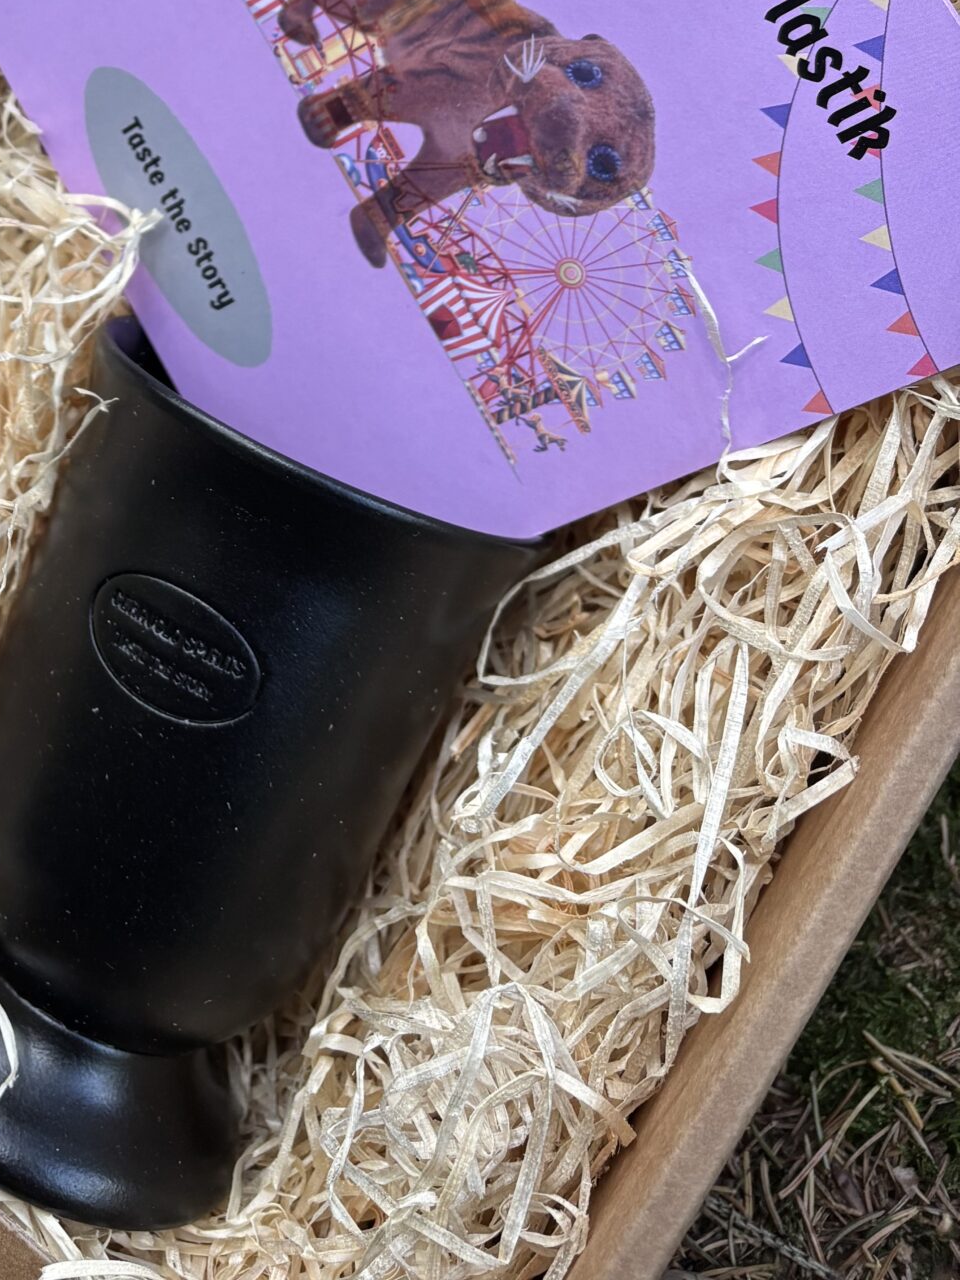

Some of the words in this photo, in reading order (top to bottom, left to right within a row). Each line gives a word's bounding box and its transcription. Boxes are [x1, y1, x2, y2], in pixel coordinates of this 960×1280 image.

[121, 116, 165, 186] Taste
[160, 187, 192, 234] the
[187, 236, 235, 311] Story
